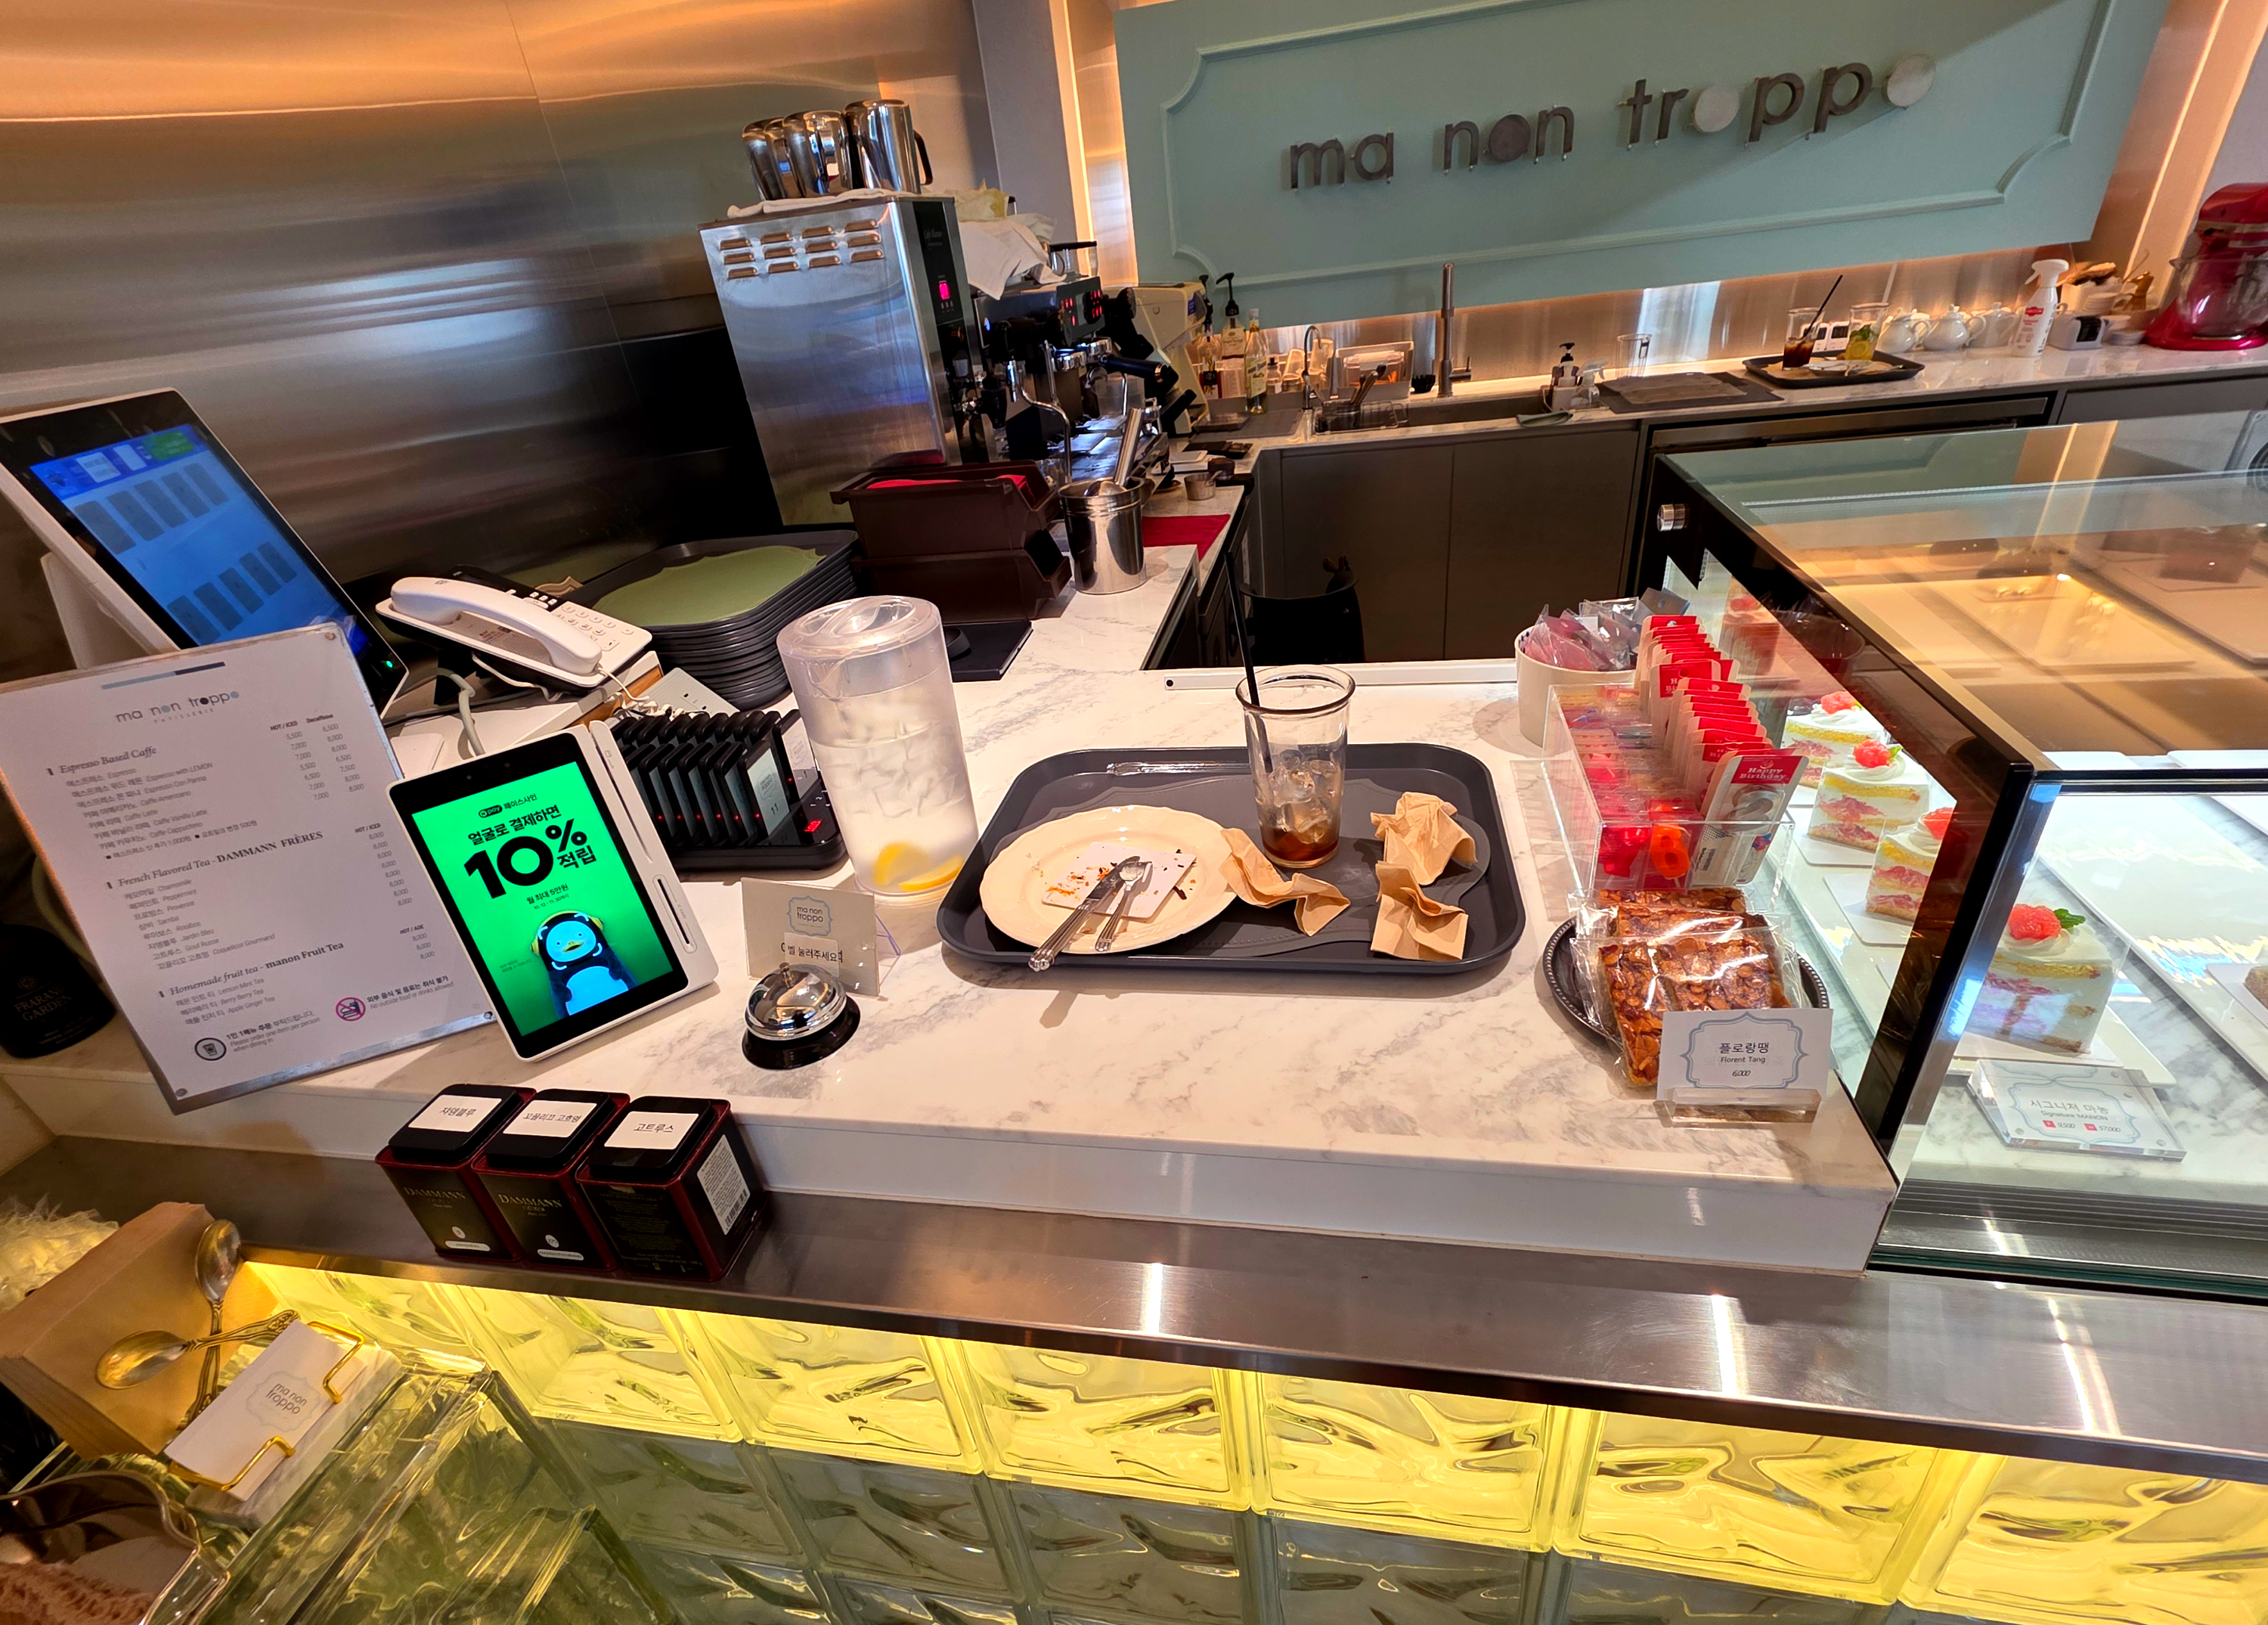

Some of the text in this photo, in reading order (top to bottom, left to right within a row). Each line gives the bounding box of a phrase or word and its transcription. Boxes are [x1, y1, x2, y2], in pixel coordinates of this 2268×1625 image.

[1289, 132, 1395, 188] ma
[1443, 104, 1575, 166] non
[115, 690, 240, 722] ma non troppo
[286, 723, 339, 740] 5,500 6,500
[290, 733, 342, 750] 7,000 8,000
[295, 743, 347, 760] 7,000 8,000
[57, 760, 99, 774] Espresso
[100, 751, 129, 764] Based
[299, 753, 352, 771] 5,500 6,500
[107, 768, 137, 779] Espresso
[304, 763, 355, 780] 6,500 7,500
[1739, 773, 1786, 781] Birthday
[1748, 768, 1784, 777] Happy
[308, 773, 360, 790] 7,000 8,000
[313, 783, 364, 800] 7,000 8,000
[503, 793, 538, 810] 페이스사인
[770, 802, 779, 816] 11
[467, 805, 562, 846] 얼굴로 결제하면
[368, 831, 384, 839] 8,000
[372, 840, 388, 849] 8,000
[117, 831, 323, 886] French Flavored Tea DAMMANN FRÈRES
[376, 850, 392, 859] 8,000
[463, 819, 588, 900] 10%
[556, 845, 597, 869] 적립
[381, 860, 396, 868] 8,000
[385, 869, 400, 878] 8,000
[389, 878, 404, 887] 8,000
[392, 888, 408, 896] 8,000
[526, 883, 569, 904] 월 최대 5만원
[397, 897, 412, 906] 8,000
[797, 912, 824, 923] troppo
[143, 921, 201, 939] 루이보스 Rooibos
[411, 932, 427, 941] 8,000
[416, 941, 431, 950] 8,000
[787, 945, 795, 956] 벨
[798, 947, 838, 962] 눌러주세요
[420, 951, 435, 959] 8,000
[169, 942, 344, 995] Homemade fruit tea manon Fruit Tea
[218, 985, 239, 994] Lemon
[380, 990, 394, 999] 음식
[402, 984, 420, 993] 음료는
[422, 978, 435, 987] 취식
[435, 975, 448, 984] 불가
[13, 984, 66, 1013] FRARANG
[378, 997, 398, 1006] outside
[398, 992, 411, 1000] food
[417, 988, 433, 996] drinks
[22, 993, 73, 1021] GARDEN
[180, 1003, 209, 1015] 베리베리
[220, 997, 236, 1005] Berry
[227, 1004, 243, 1013] Apple
[243, 999, 263, 1008] Ginger
[225, 1031, 238, 1040] 1인
[238, 1028, 256, 1036] 1메뉴
[258, 1022, 271, 1031] 주문
[229, 1037, 249, 1047] Please
[249, 1033, 265, 1041] order
[299, 1017, 321, 1028] person
[249, 1039, 267, 1048] dining
[1718, 1042, 1770, 1054] 플로랑땡
[1749, 1056, 1766, 1064] Tang
[439, 1106, 478, 1118] 자뎅블루
[2031, 1099, 2109, 1115] 시그니처 마농
[2040, 1110, 2075, 1118] Signature
[633, 1123, 674, 1133] 고트루스
[403, 1186, 467, 1200] DAMMANN
[497, 1193, 563, 1208] DAMMANN
[265, 1389, 301, 1415] troppo
[271, 1383, 308, 1406] ma non
